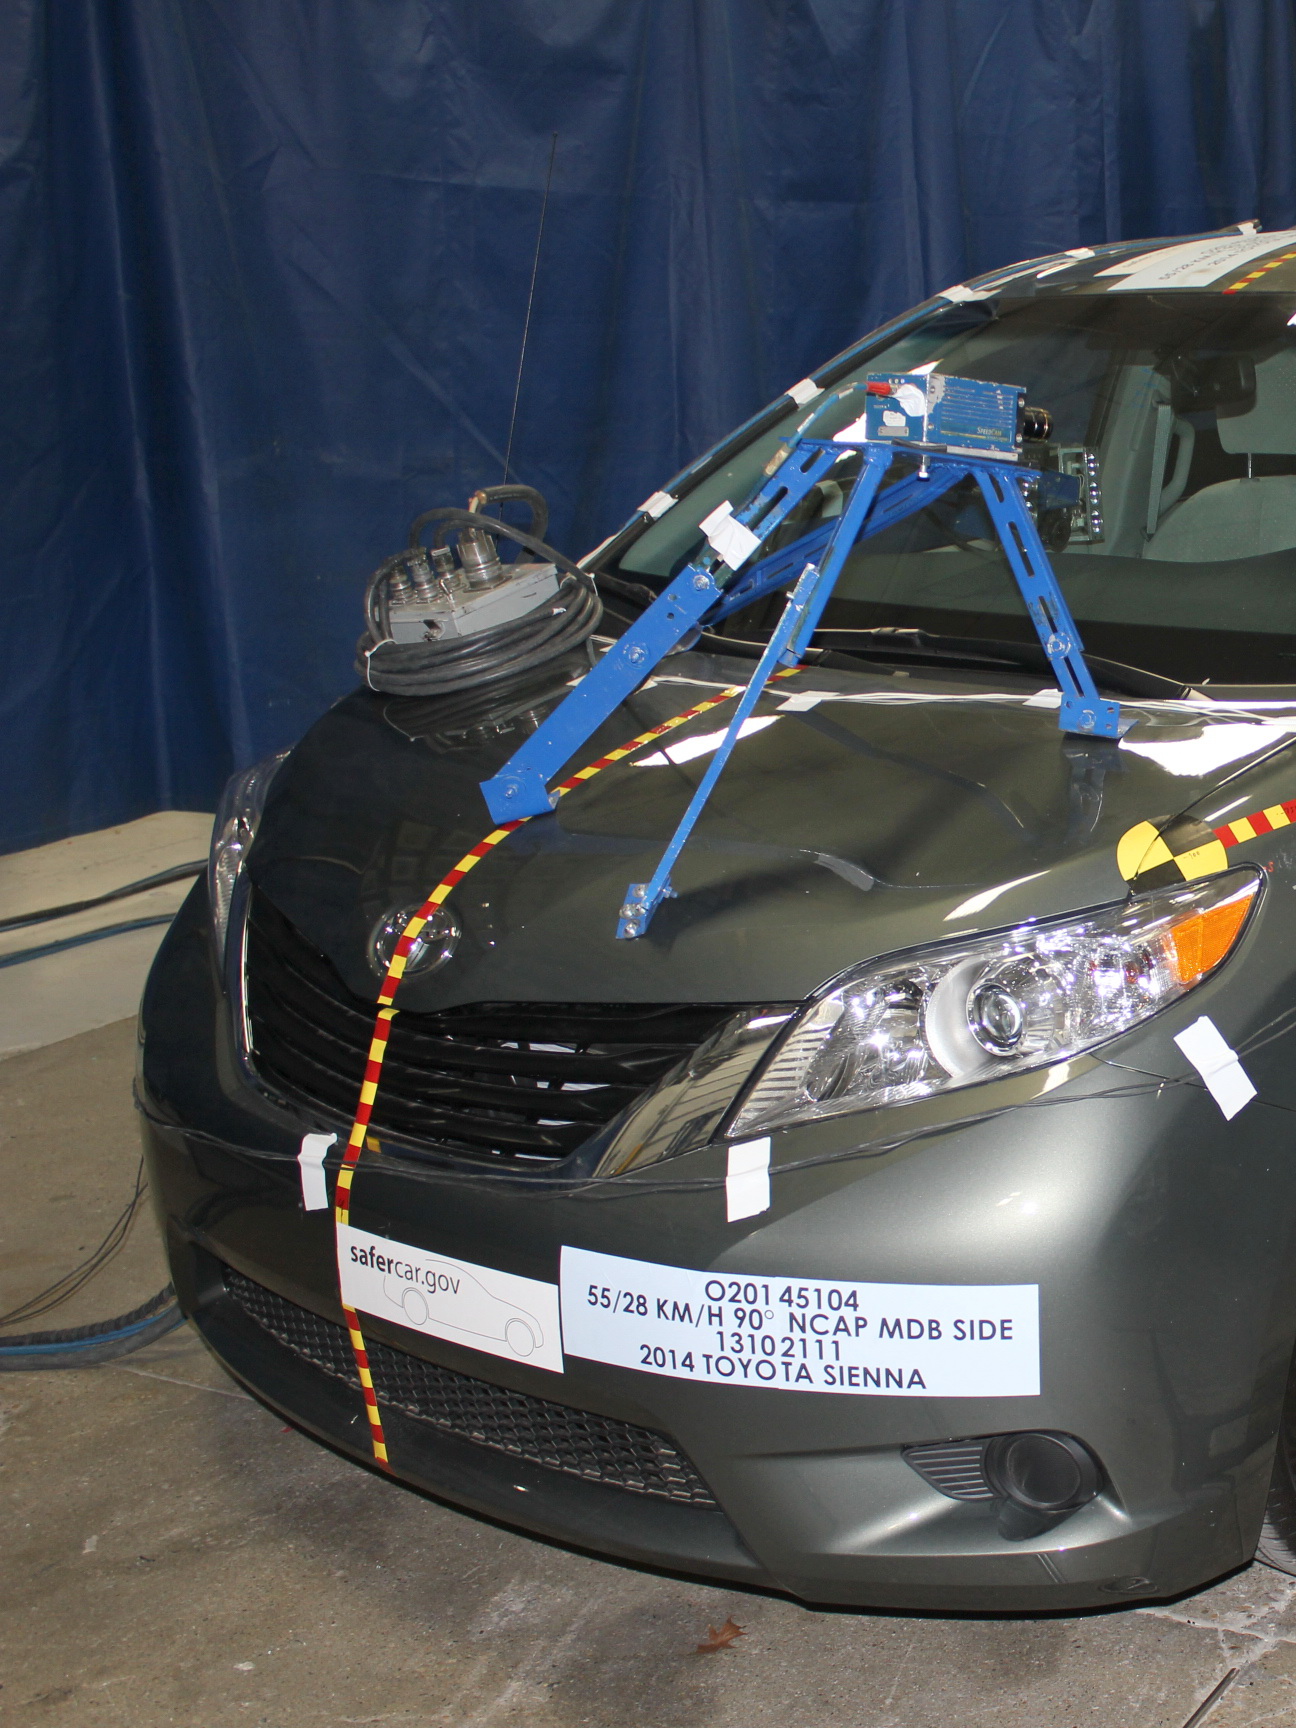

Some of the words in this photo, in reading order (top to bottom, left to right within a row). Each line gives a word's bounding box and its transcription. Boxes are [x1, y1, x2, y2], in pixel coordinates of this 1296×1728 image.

[350, 1244, 460, 1295] safercar.gov
[587, 1285, 649, 1317] 55/28
[656, 1298, 724, 1327] KM/H
[788, 1312, 868, 1337] NCAP
[879, 1317, 943, 1341] MDB
[952, 1318, 1014, 1341] SIDE
[640, 1344, 695, 1373] 2014
[702, 1354, 814, 1384] TOYOTA
[823, 1364, 927, 1390] SIENNA
[716, 1330, 841, 1361] 13102111
